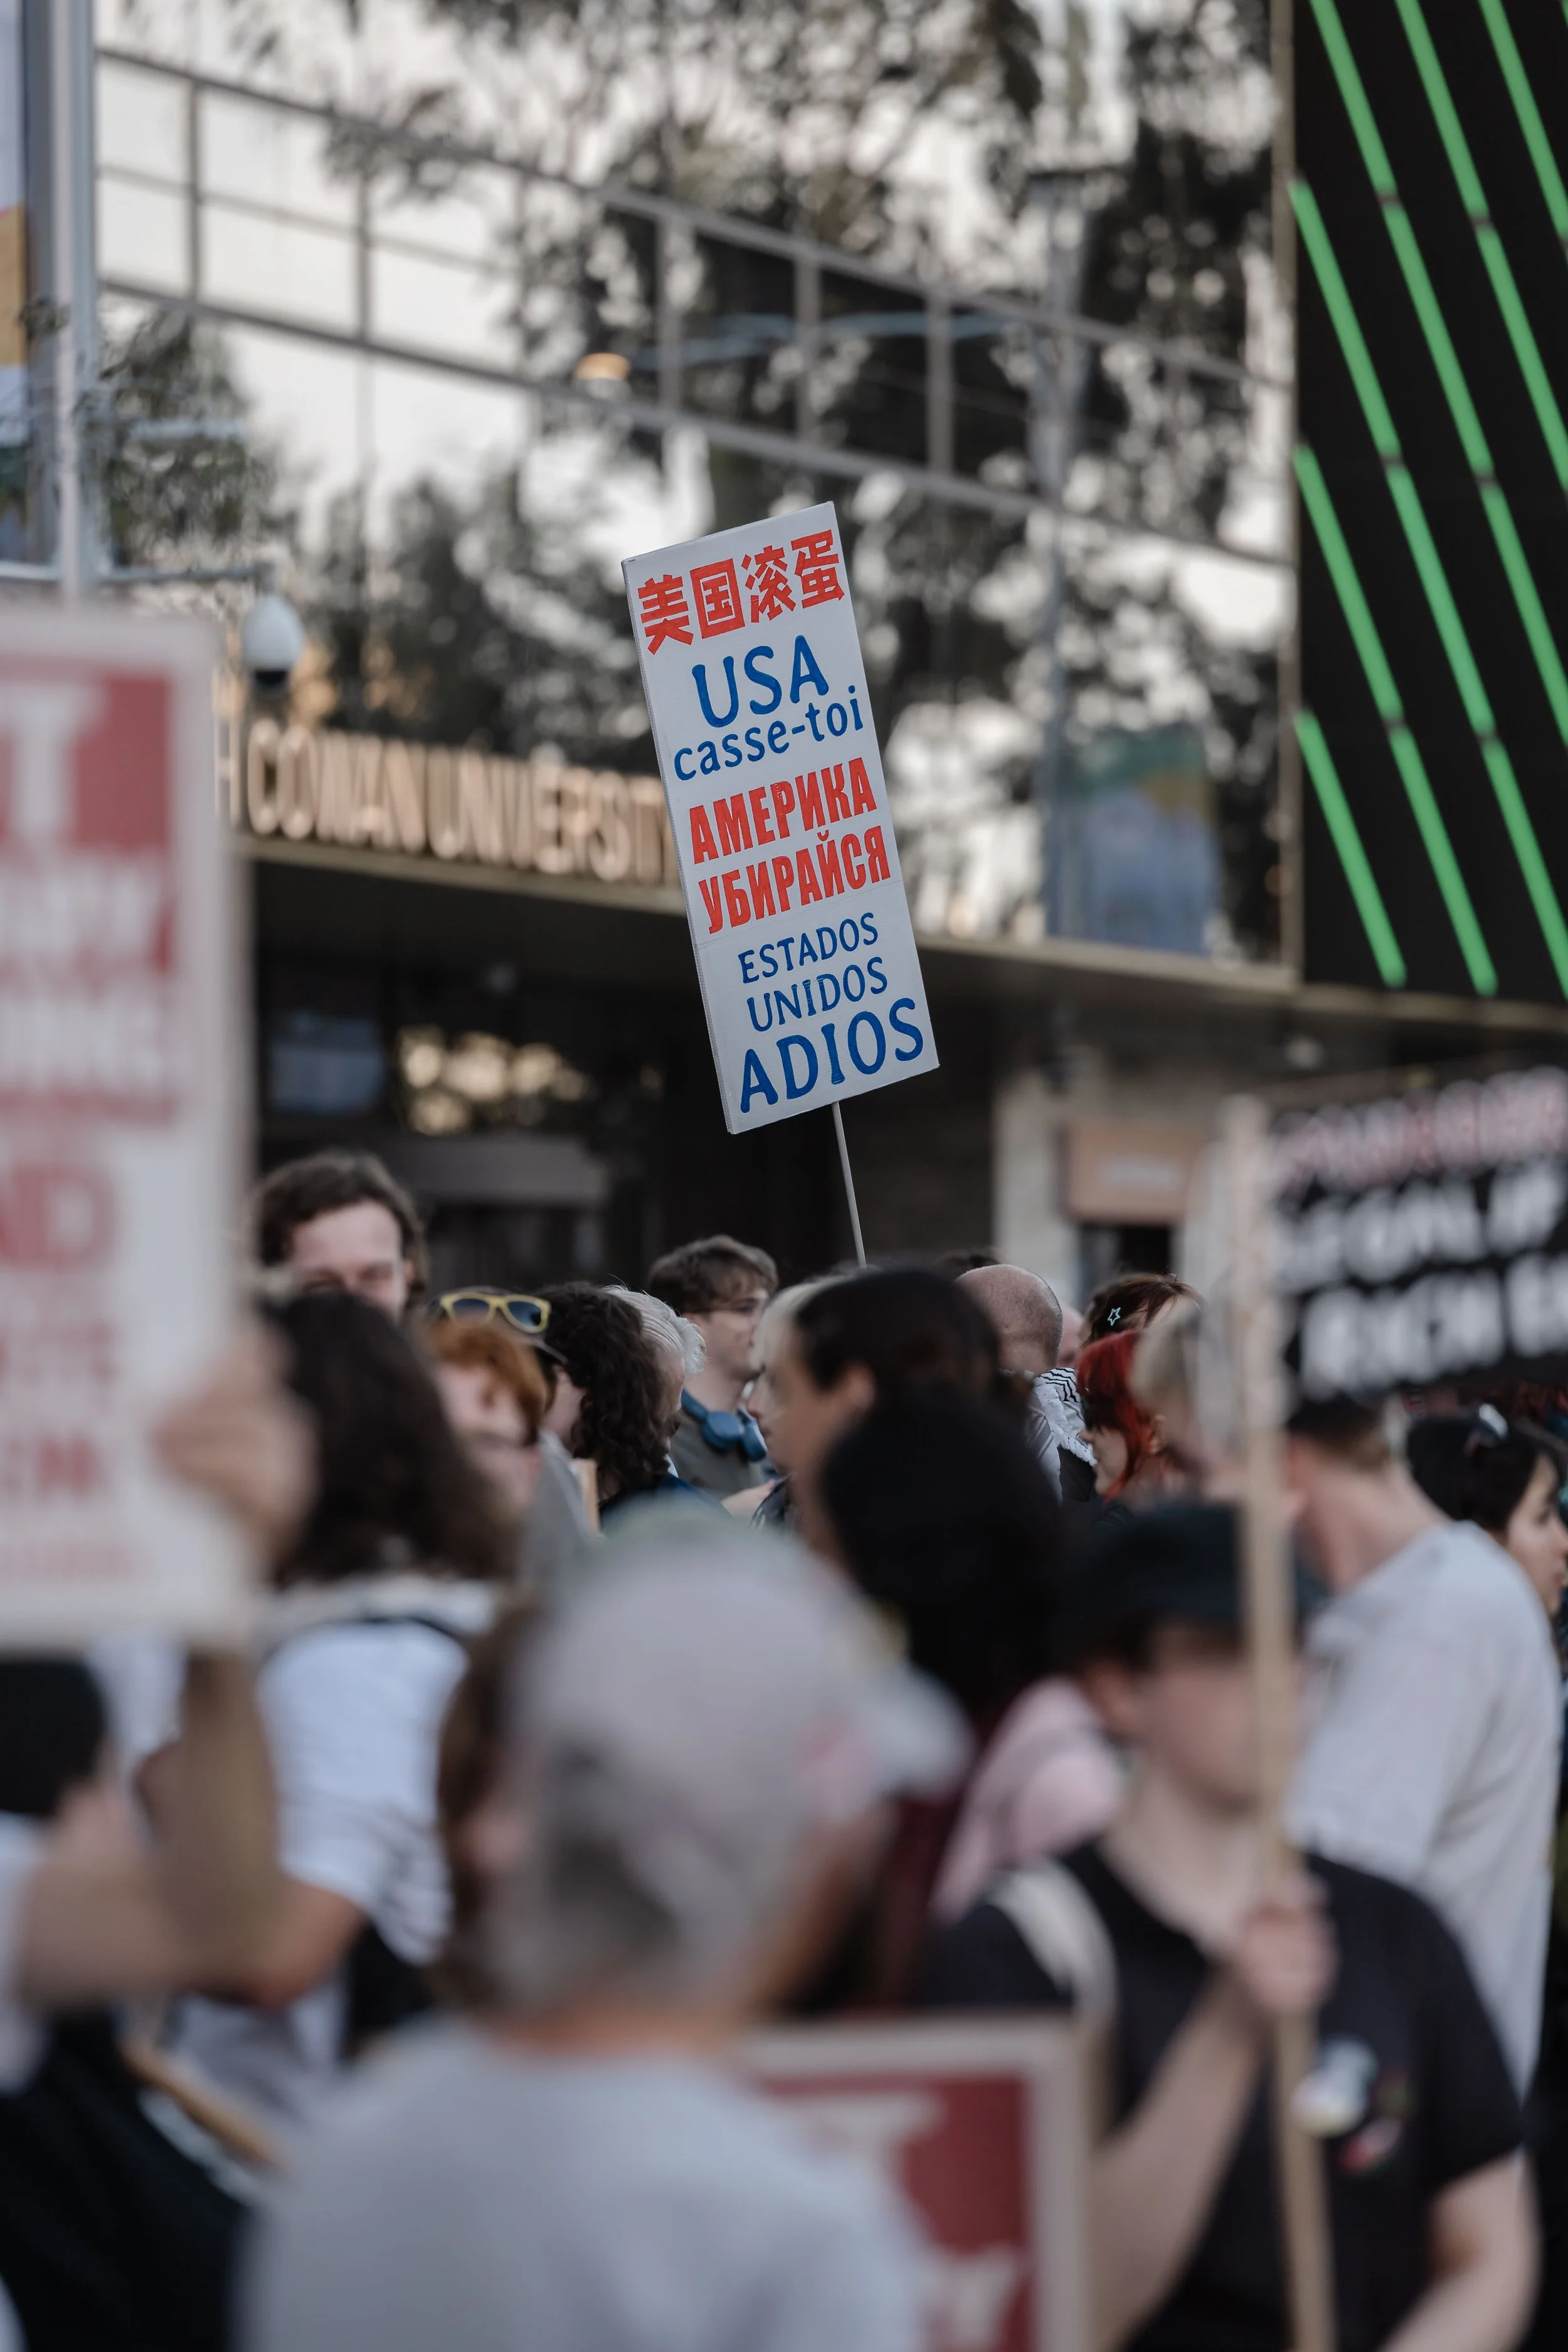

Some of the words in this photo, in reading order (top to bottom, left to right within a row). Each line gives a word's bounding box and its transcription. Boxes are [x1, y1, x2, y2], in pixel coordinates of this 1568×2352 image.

[637, 529, 845, 655] 美国滚蛋
[691, 635, 830, 728] USA
[674, 685, 864, 781] casse-toi
[689, 757, 877, 864] АМЕРИКА
[698, 825, 891, 935] УБИРАЙСЯ
[738, 912, 879, 984] ESTADOS
[746, 956, 888, 1032] UNIDOS
[739, 997, 924, 1113] ADIOS
